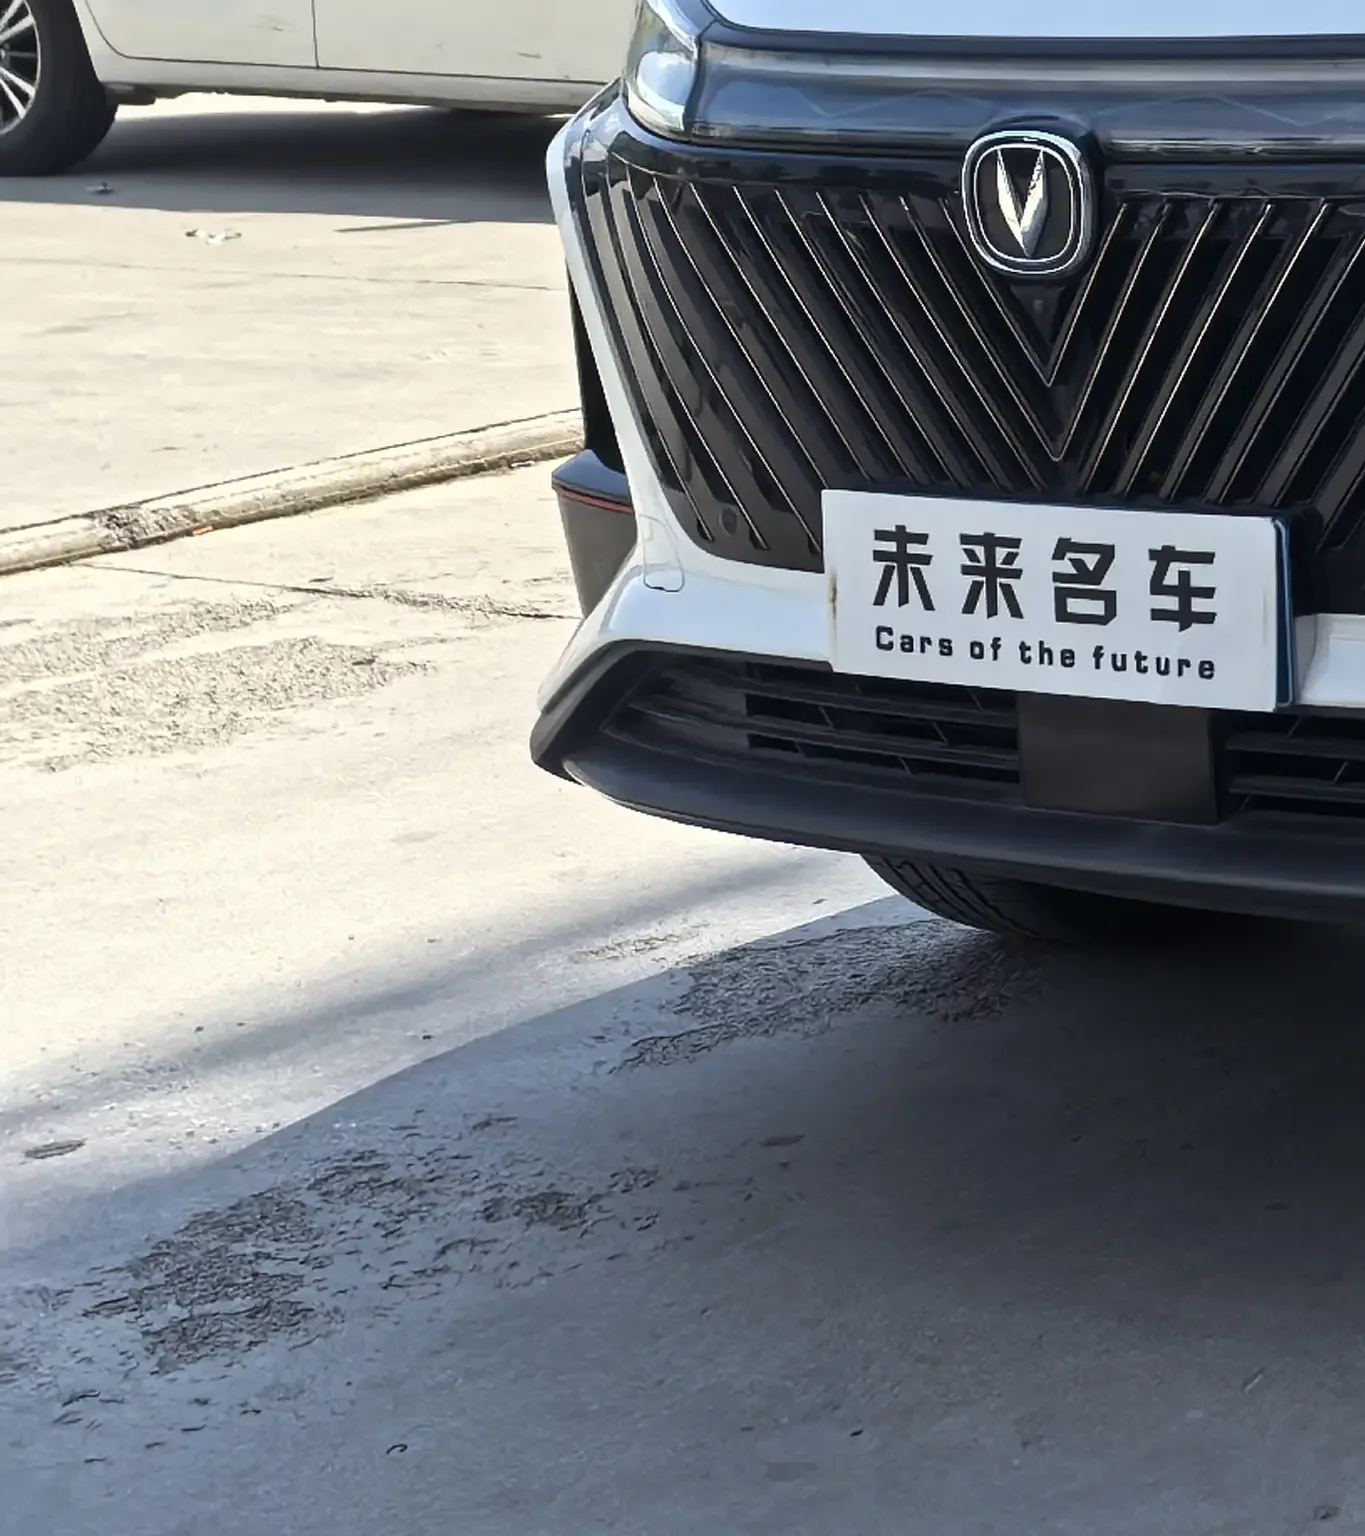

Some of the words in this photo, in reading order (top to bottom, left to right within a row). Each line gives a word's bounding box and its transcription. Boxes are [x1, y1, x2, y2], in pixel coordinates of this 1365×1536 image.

[872, 524, 1217, 632] 未来名车
[875, 625, 953, 657] Cars
[969, 636, 1002, 661] of
[1018, 640, 1076, 668] the
[1092, 645, 1216, 679] future
